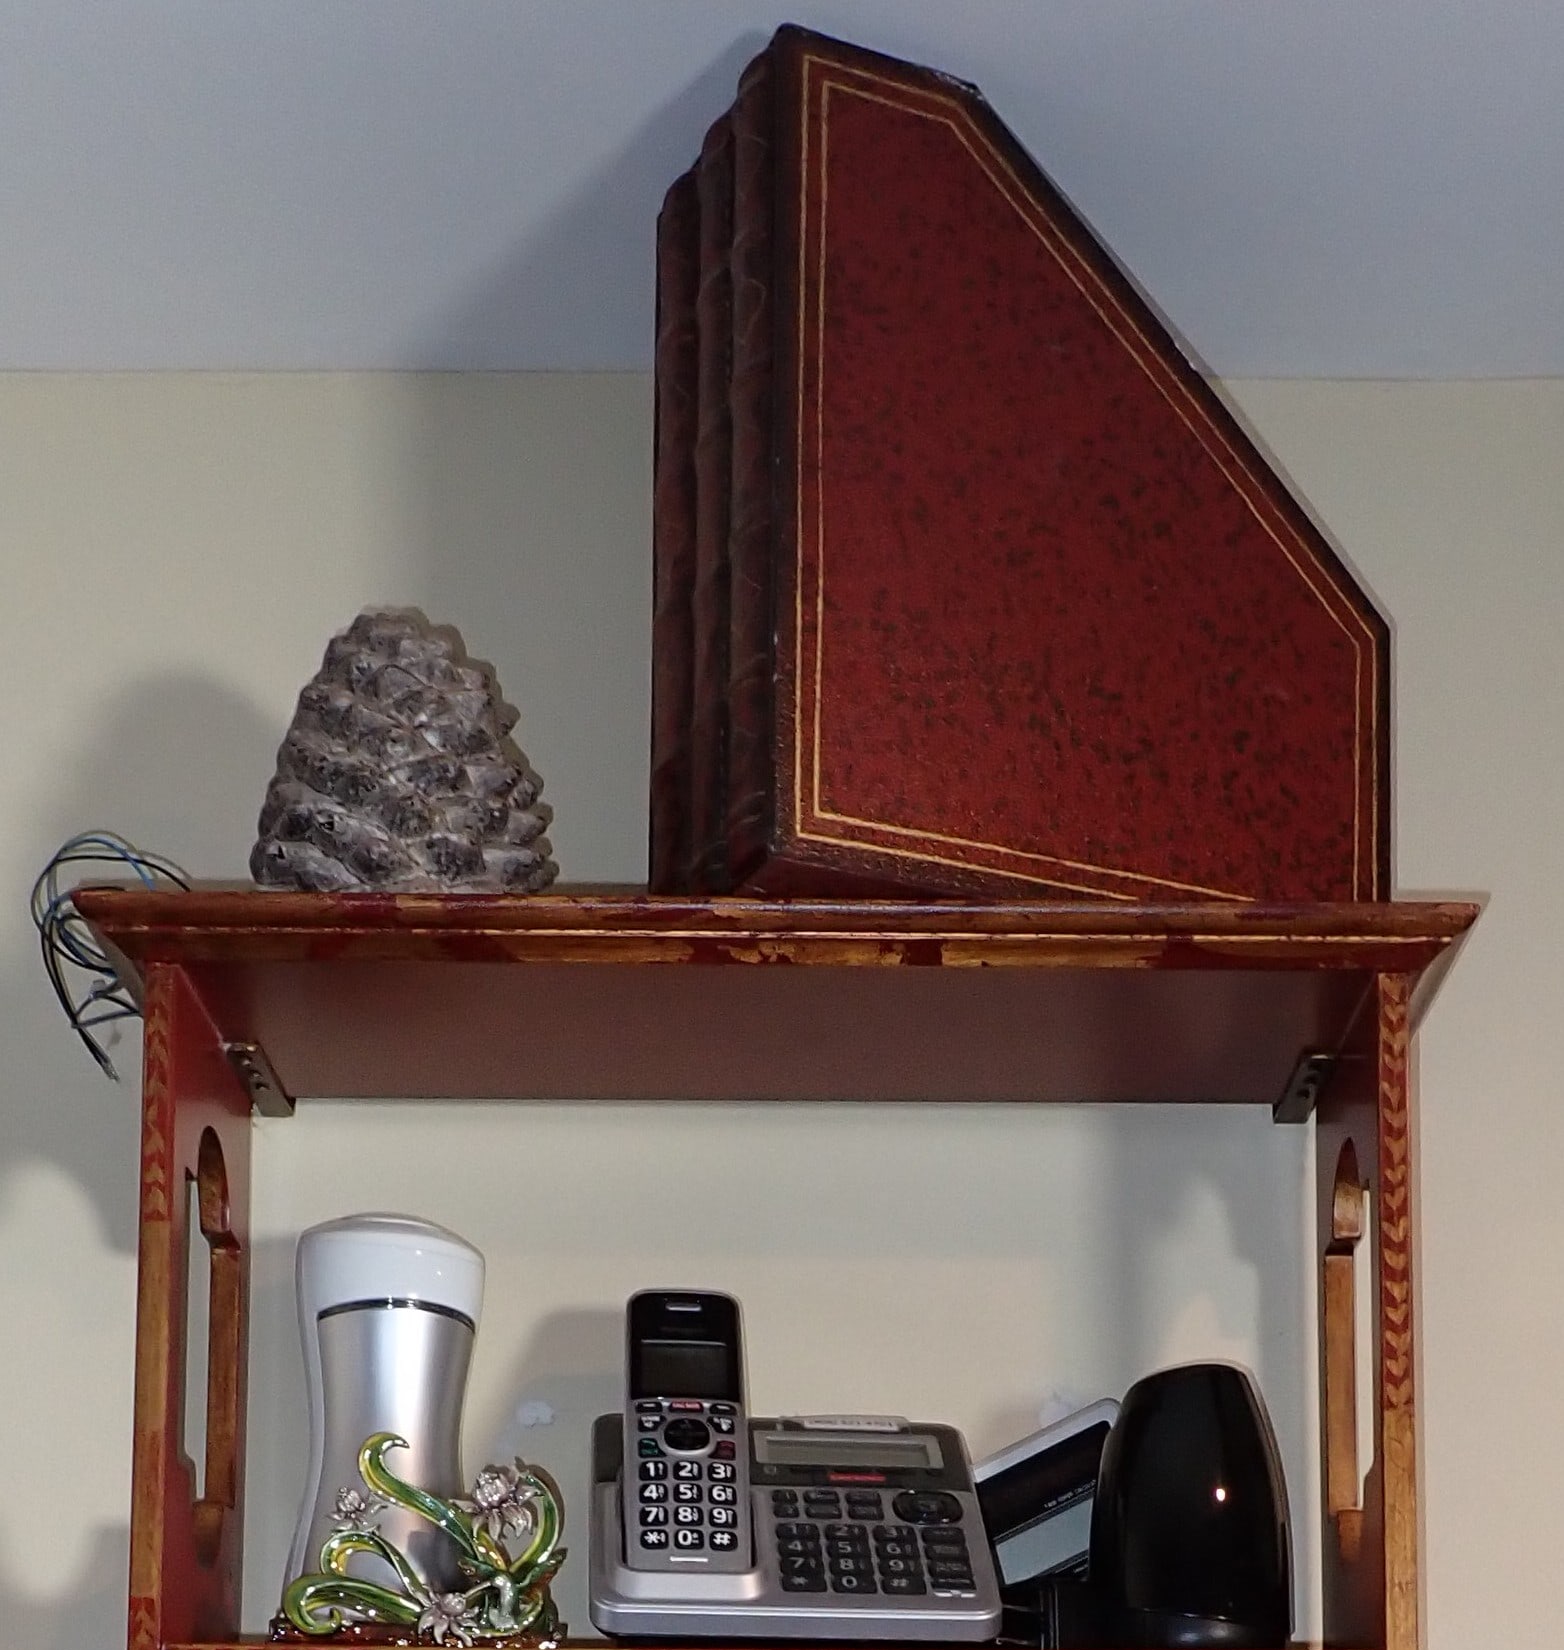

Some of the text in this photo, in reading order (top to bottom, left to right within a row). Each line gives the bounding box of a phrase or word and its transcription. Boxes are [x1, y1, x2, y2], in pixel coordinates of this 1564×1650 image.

[678, 1461, 693, 1477] 2
[712, 1463, 726, 1478] 3
[643, 1484, 659, 1500] 4
[679, 1484, 693, 1499] 5
[712, 1485, 726, 1501] 6
[645, 1506, 658, 1523] 7
[678, 1506, 693, 1522] 8
[712, 1508, 727, 1523] 9
[678, 1530, 693, 1545] 0
